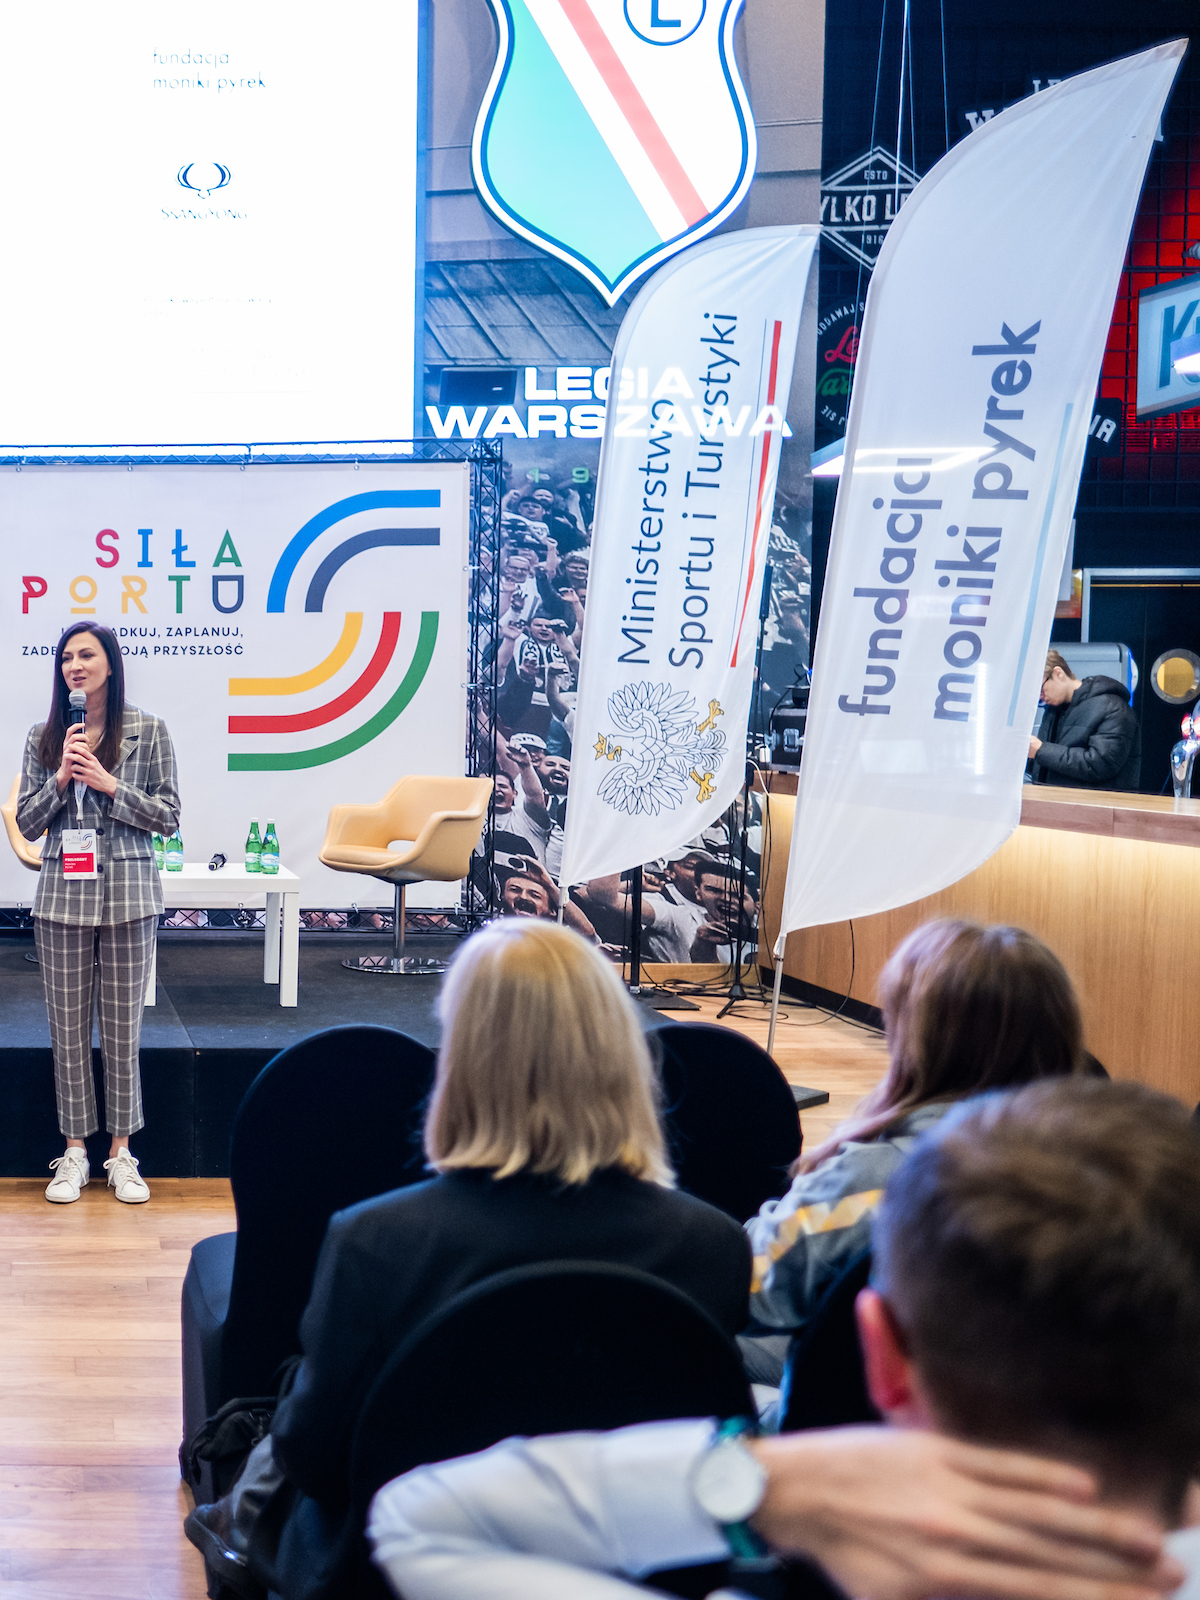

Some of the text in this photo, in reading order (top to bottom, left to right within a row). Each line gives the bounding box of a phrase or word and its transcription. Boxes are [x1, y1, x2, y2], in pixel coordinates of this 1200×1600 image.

[154, 46, 229, 68] fundacja
[154, 71, 266, 93] moniki pyrek
[820, 194, 877, 222] YLKO
[524, 366, 695, 401] LEGIA
[425, 404, 794, 439] WARSZAWA
[668, 312, 740, 670] Sportu i Turystyki
[617, 398, 675, 664] Ministerstwo
[933, 319, 1042, 722] moniki pyrek
[95, 528, 243, 569] SIŁA
[837, 457, 943, 717] fundacja
[120, 645, 149, 659] OJĄ
[153, 642, 244, 656] PRZYSZŁOŚĆ
[166, 627, 244, 639] ZAPLANUJ,
